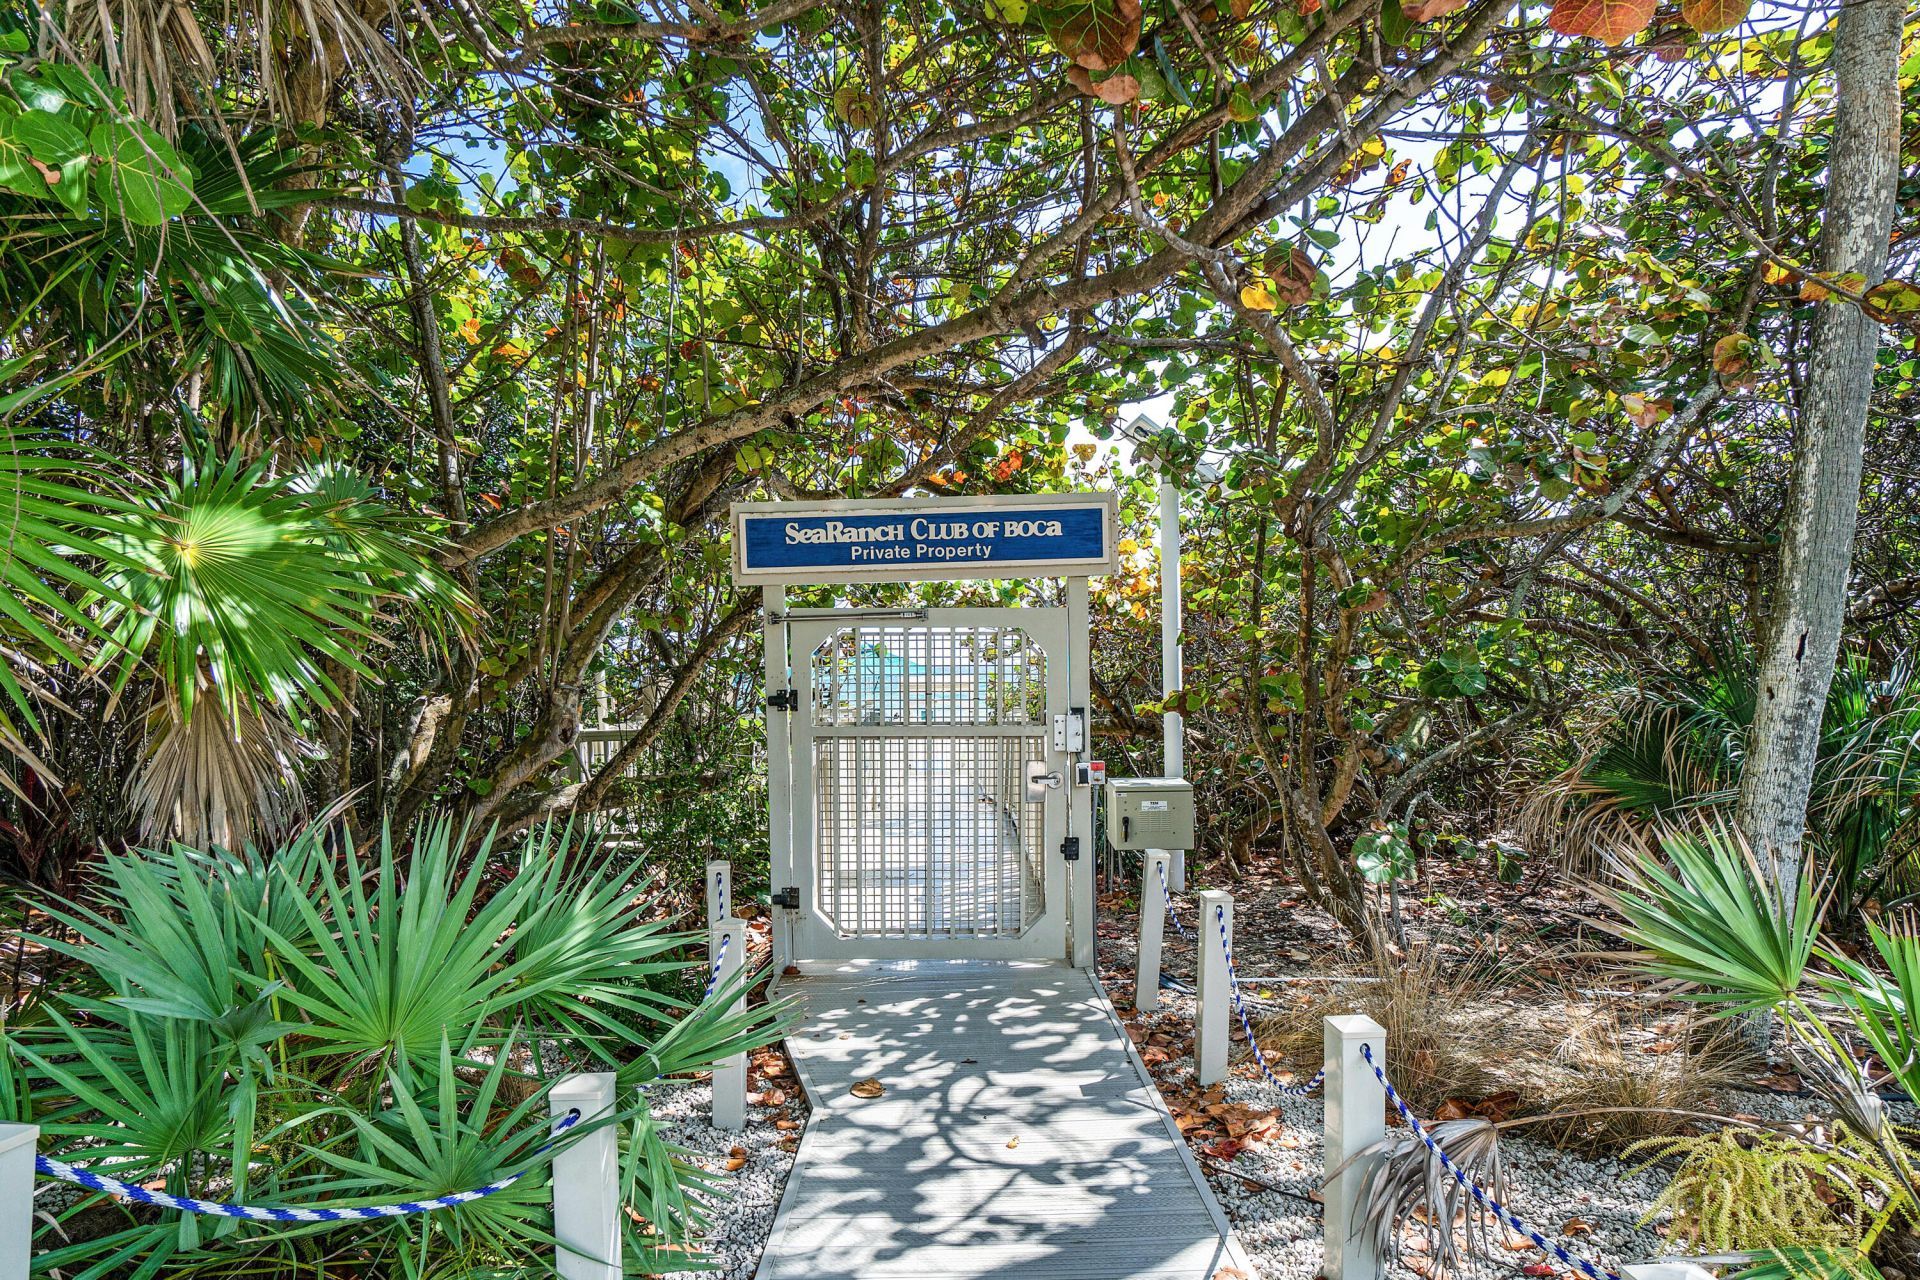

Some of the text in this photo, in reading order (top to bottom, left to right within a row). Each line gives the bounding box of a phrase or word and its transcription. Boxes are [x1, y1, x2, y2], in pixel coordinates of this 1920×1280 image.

[910, 518, 969, 540] CLUB
[972, 522, 1000, 538] OF
[851, 543, 992, 560] Private Property
